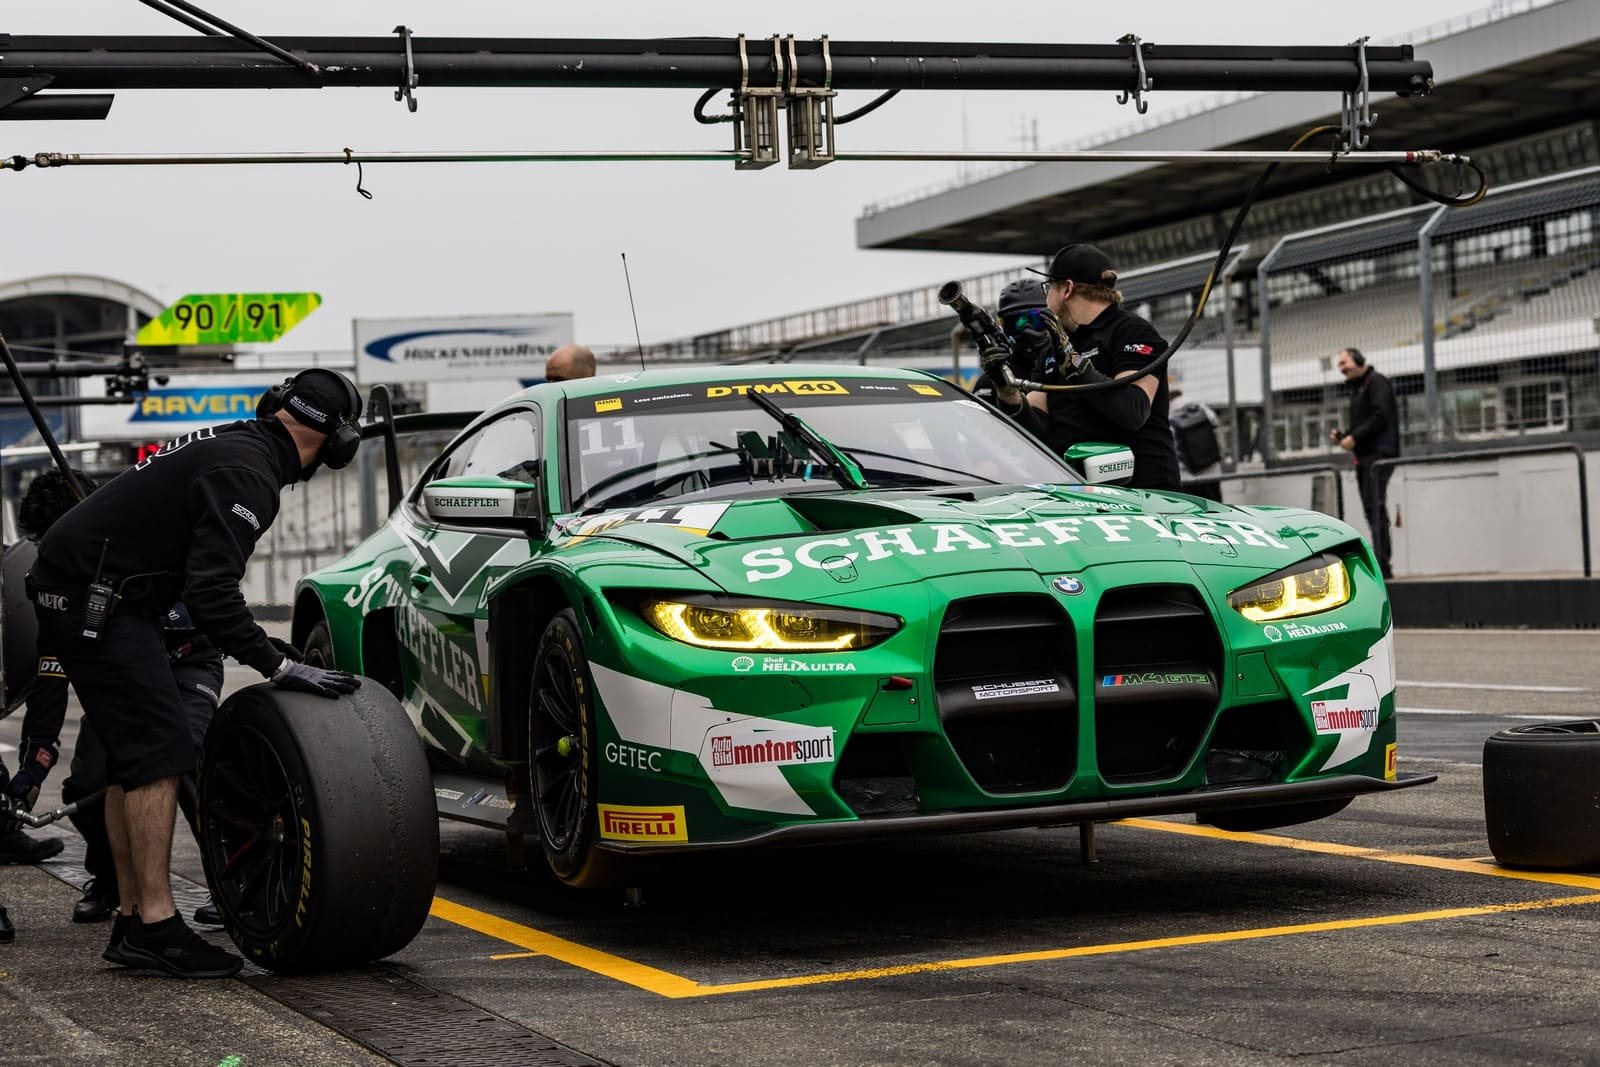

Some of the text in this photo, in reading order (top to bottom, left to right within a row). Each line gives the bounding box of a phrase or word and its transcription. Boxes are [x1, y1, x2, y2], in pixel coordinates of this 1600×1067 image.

[175, 304, 213, 330] 90
[247, 304, 281, 329] 91
[707, 383, 836, 397] DTM 40
[142, 395, 261, 416] RAVEN
[580, 418, 645, 456] 11
[433, 497, 500, 508] SCHAEFFLER
[741, 515, 1289, 583] SCHAEFFLER
[971, 679, 1055, 691] SCHUBERT
[979, 685, 1055, 698] MOTORSPORT
[605, 742, 662, 772] GETEC
[603, 810, 676, 835] PIRELLI
[295, 816, 313, 928] PIRELLI
